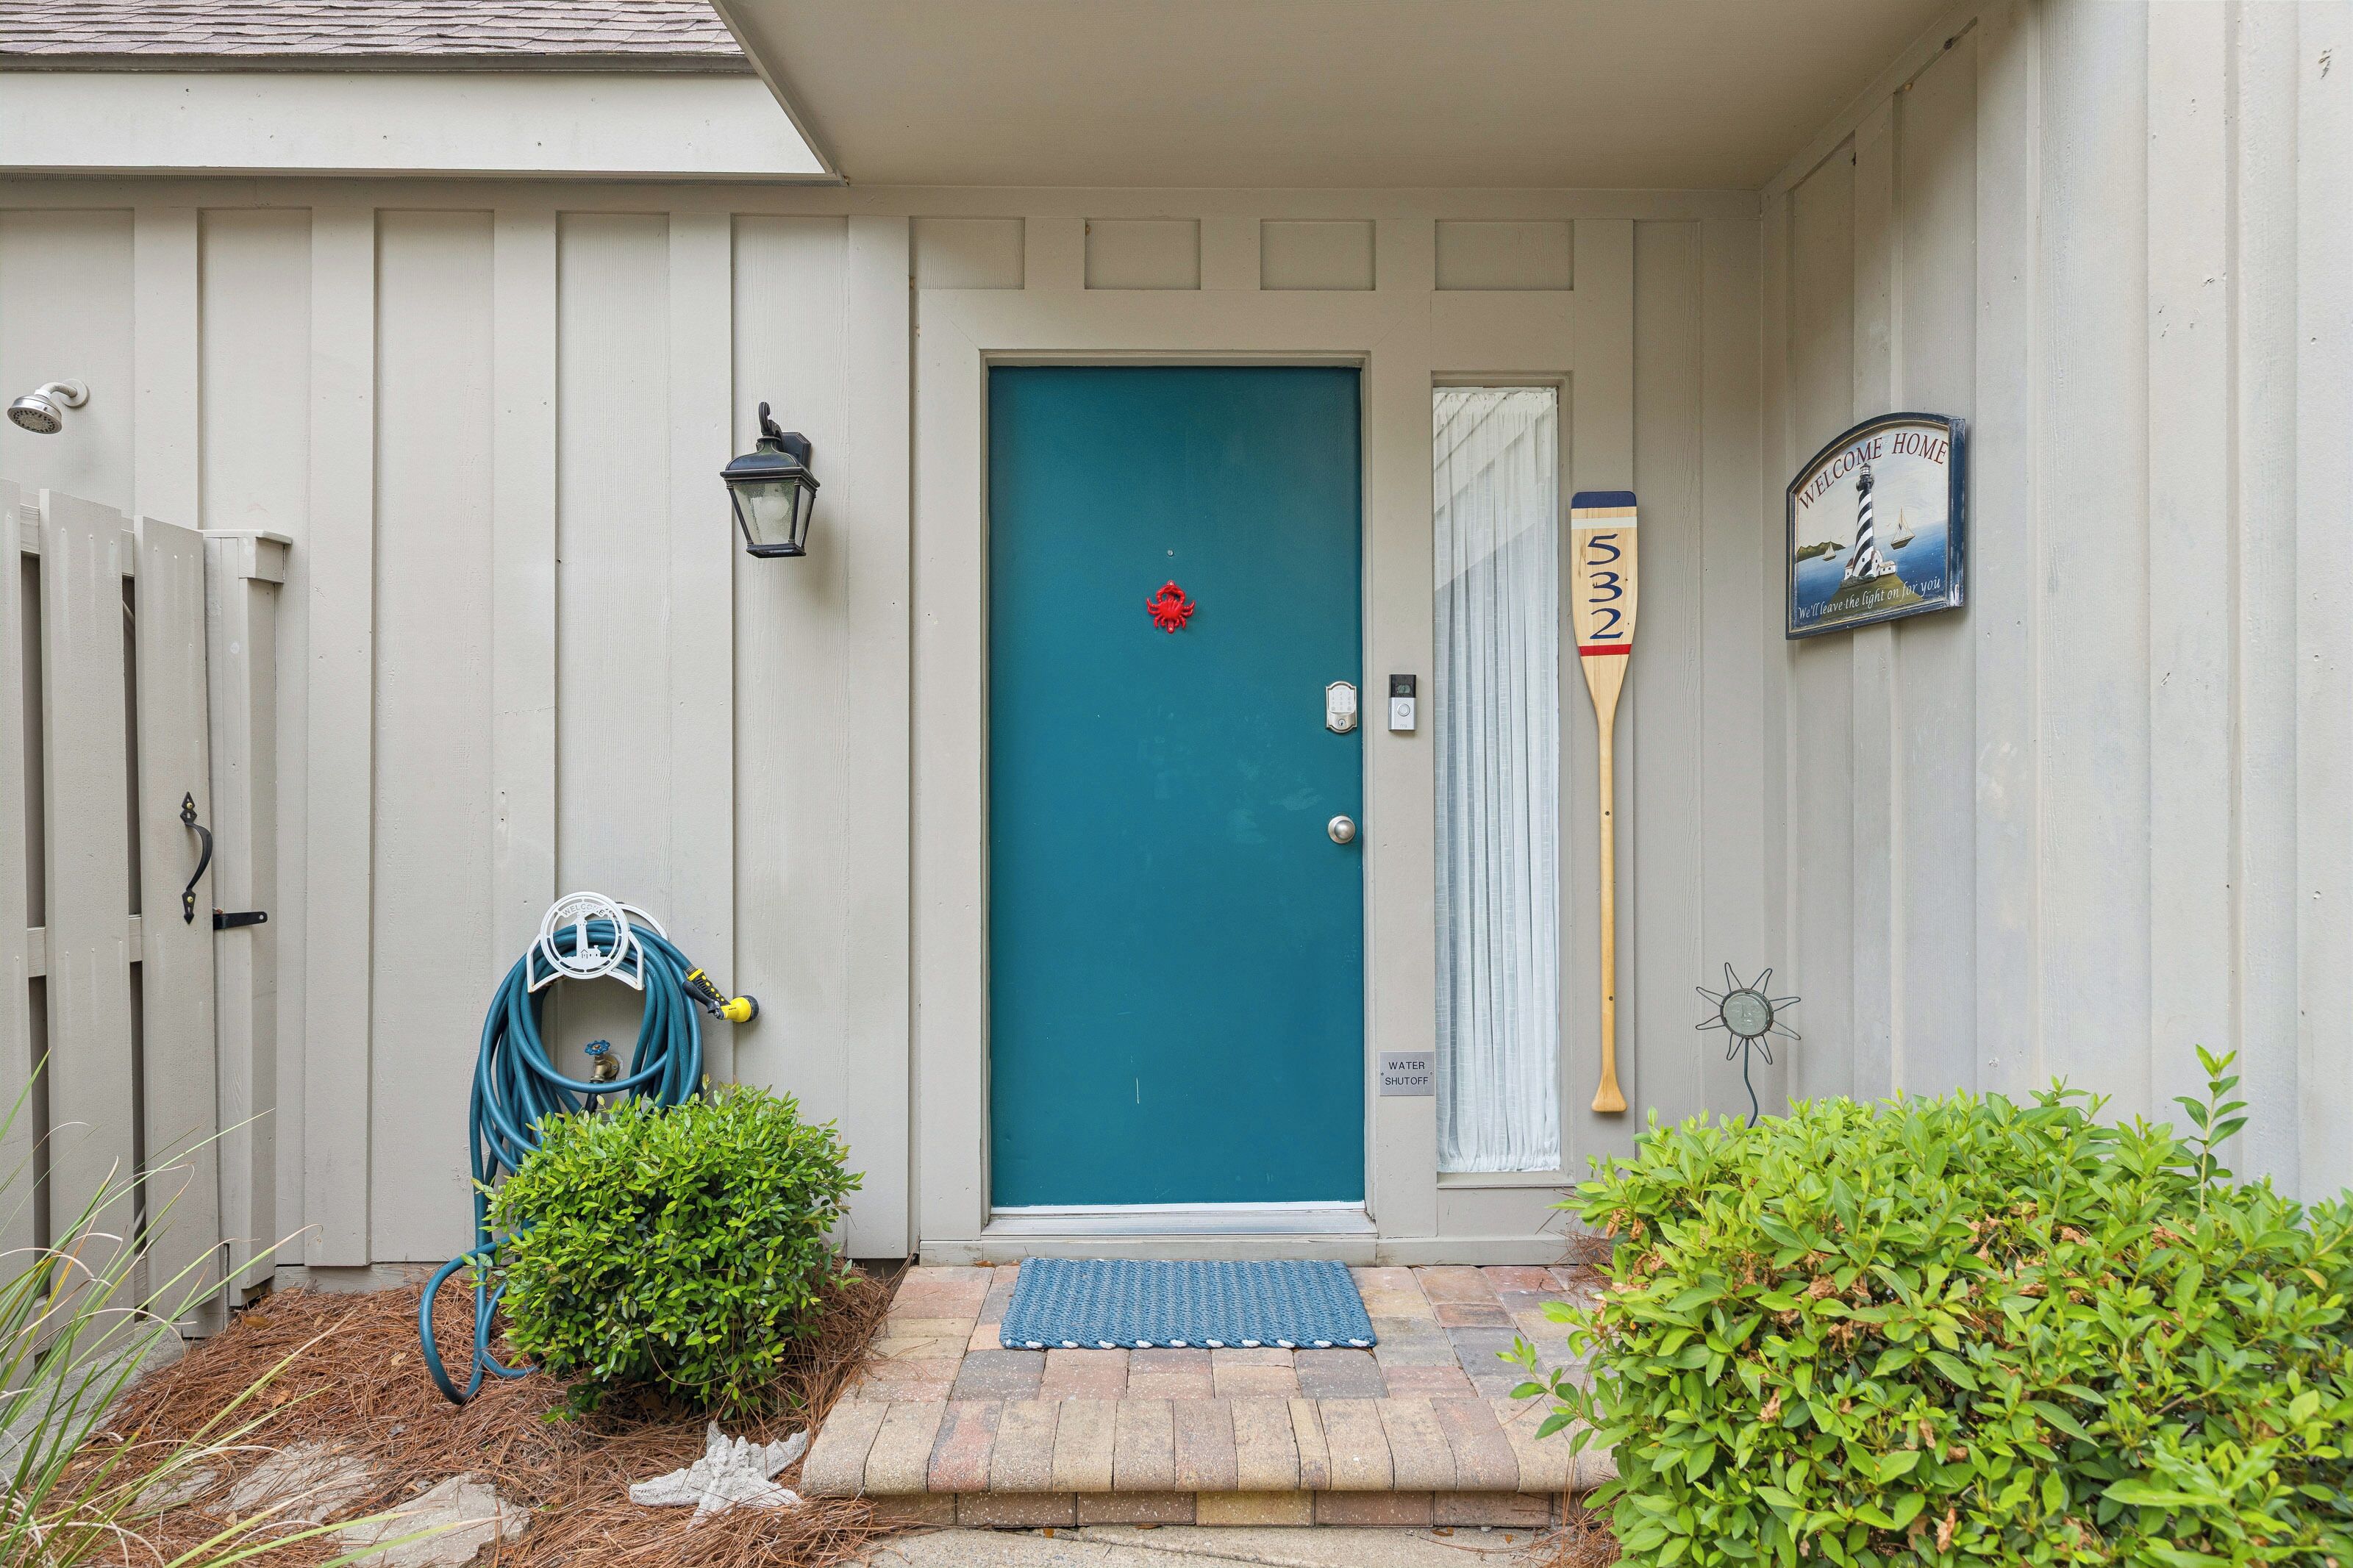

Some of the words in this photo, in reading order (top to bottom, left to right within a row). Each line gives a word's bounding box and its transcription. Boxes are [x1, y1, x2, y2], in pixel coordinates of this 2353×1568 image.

[1799, 437, 1882, 509] WELCOME
[1891, 432, 1949, 465] HOME
[1587, 533, 1624, 640] 532
[1798, 602, 1820, 620] We'll
[1820, 601, 1843, 615] leave
[1845, 594, 1860, 609] the
[1862, 587, 1884, 609] light
[1887, 588, 1899, 600] on
[1899, 581, 1918, 601] for
[1921, 577, 1940, 597] you
[1385, 1076, 1429, 1085] SHUTOFF
[1388, 1062, 1425, 1070] WATER
